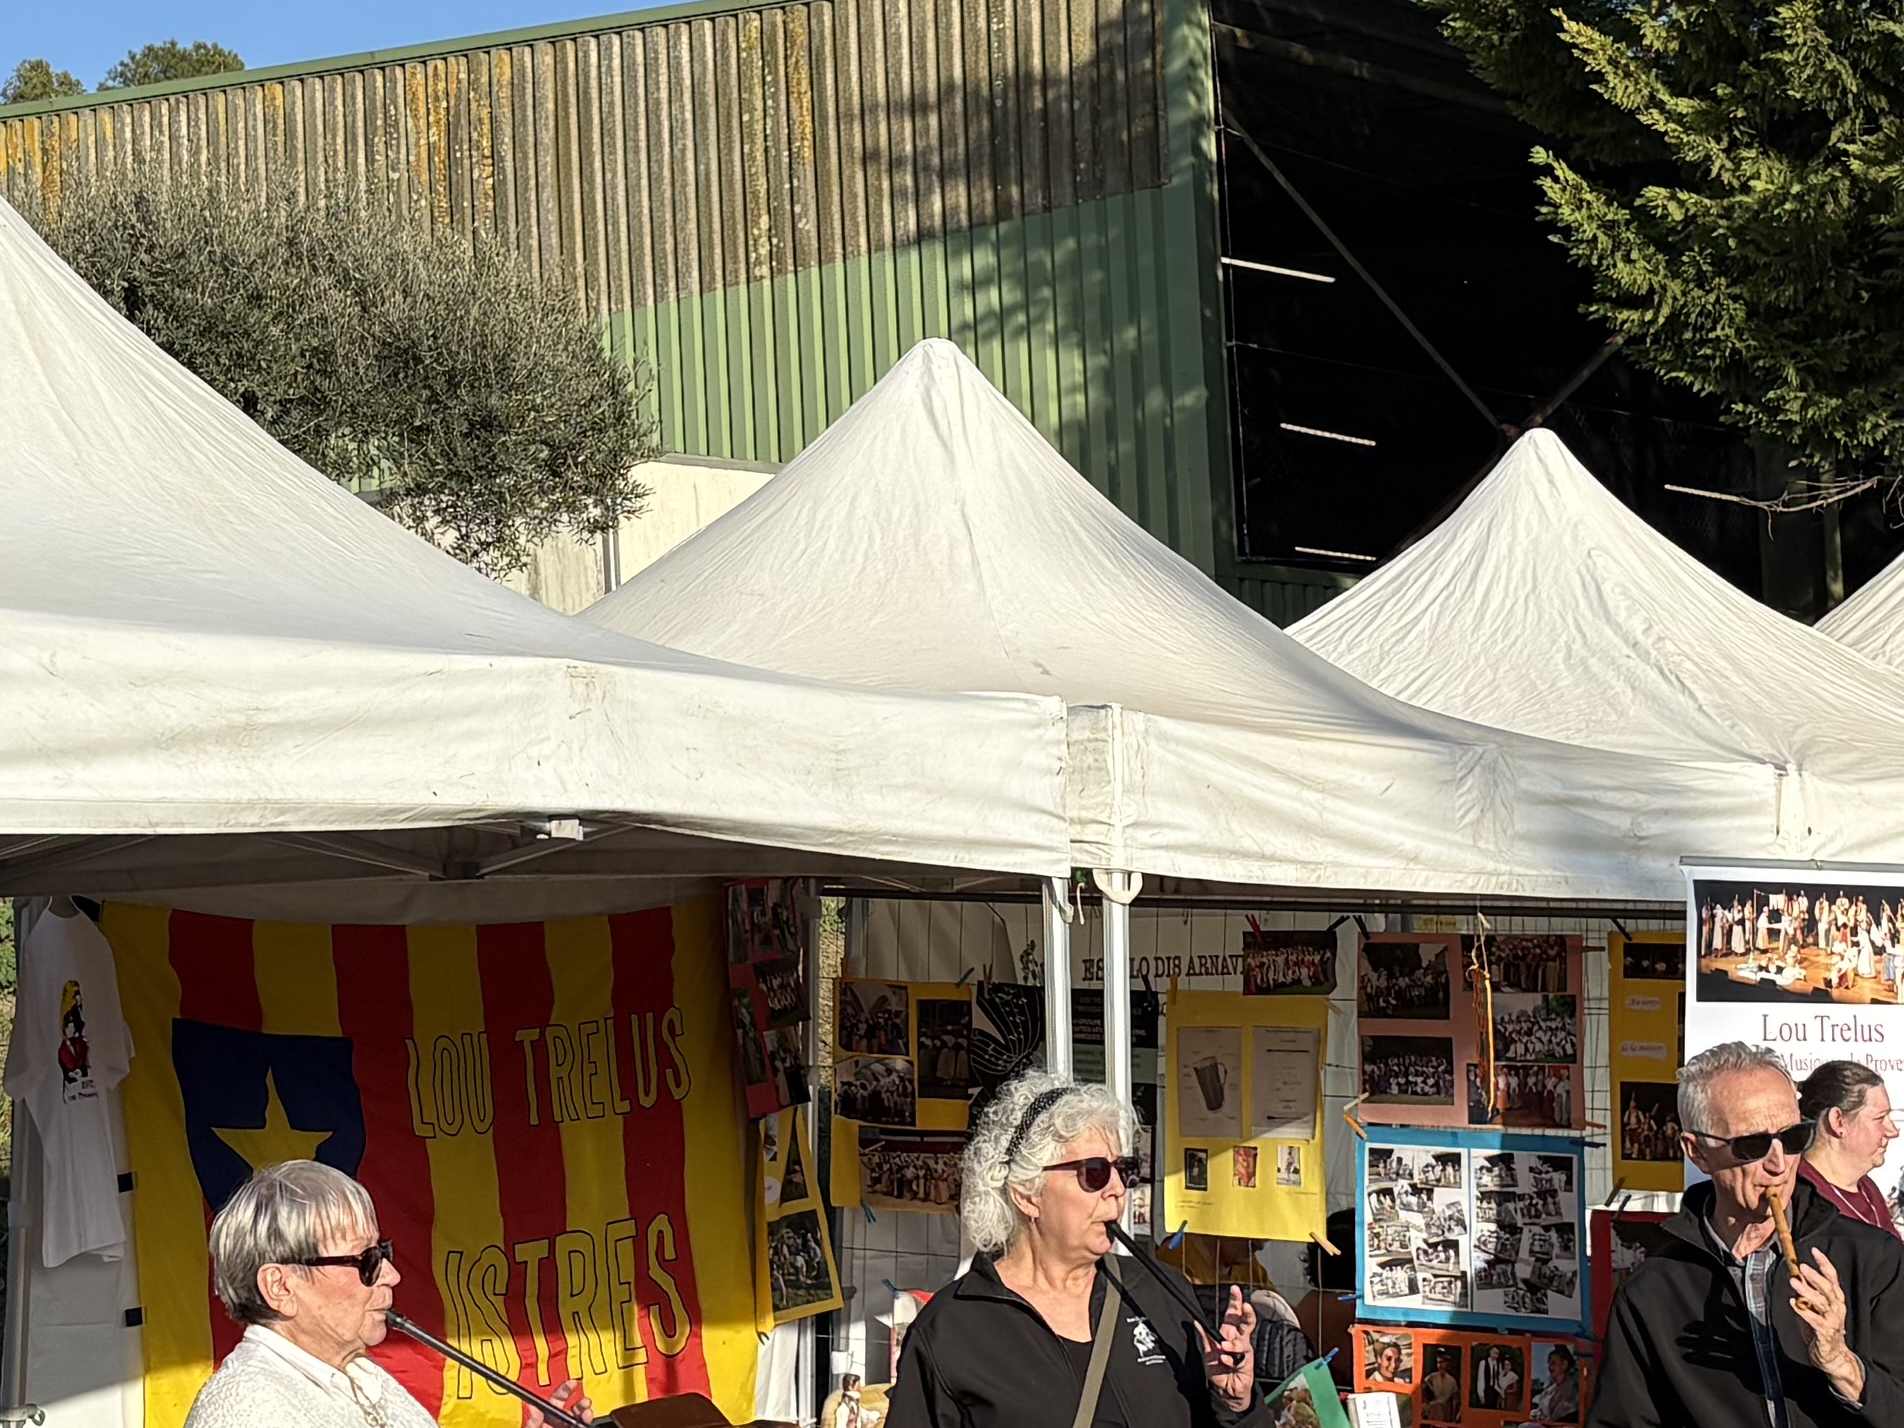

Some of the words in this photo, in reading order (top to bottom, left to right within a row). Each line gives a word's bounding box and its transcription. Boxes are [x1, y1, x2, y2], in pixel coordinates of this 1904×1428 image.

[1082, 956, 1150, 982] ESLO
[1153, 956, 1182, 978] DIS
[1185, 954, 1245, 977] ARNAV
[1761, 1014, 1807, 1042] Lou
[1814, 1014, 1885, 1043] Trelus
[405, 1031, 495, 1139] LOU
[515, 1006, 692, 1127] TRELUS
[445, 1213, 692, 1400] ISTRES
